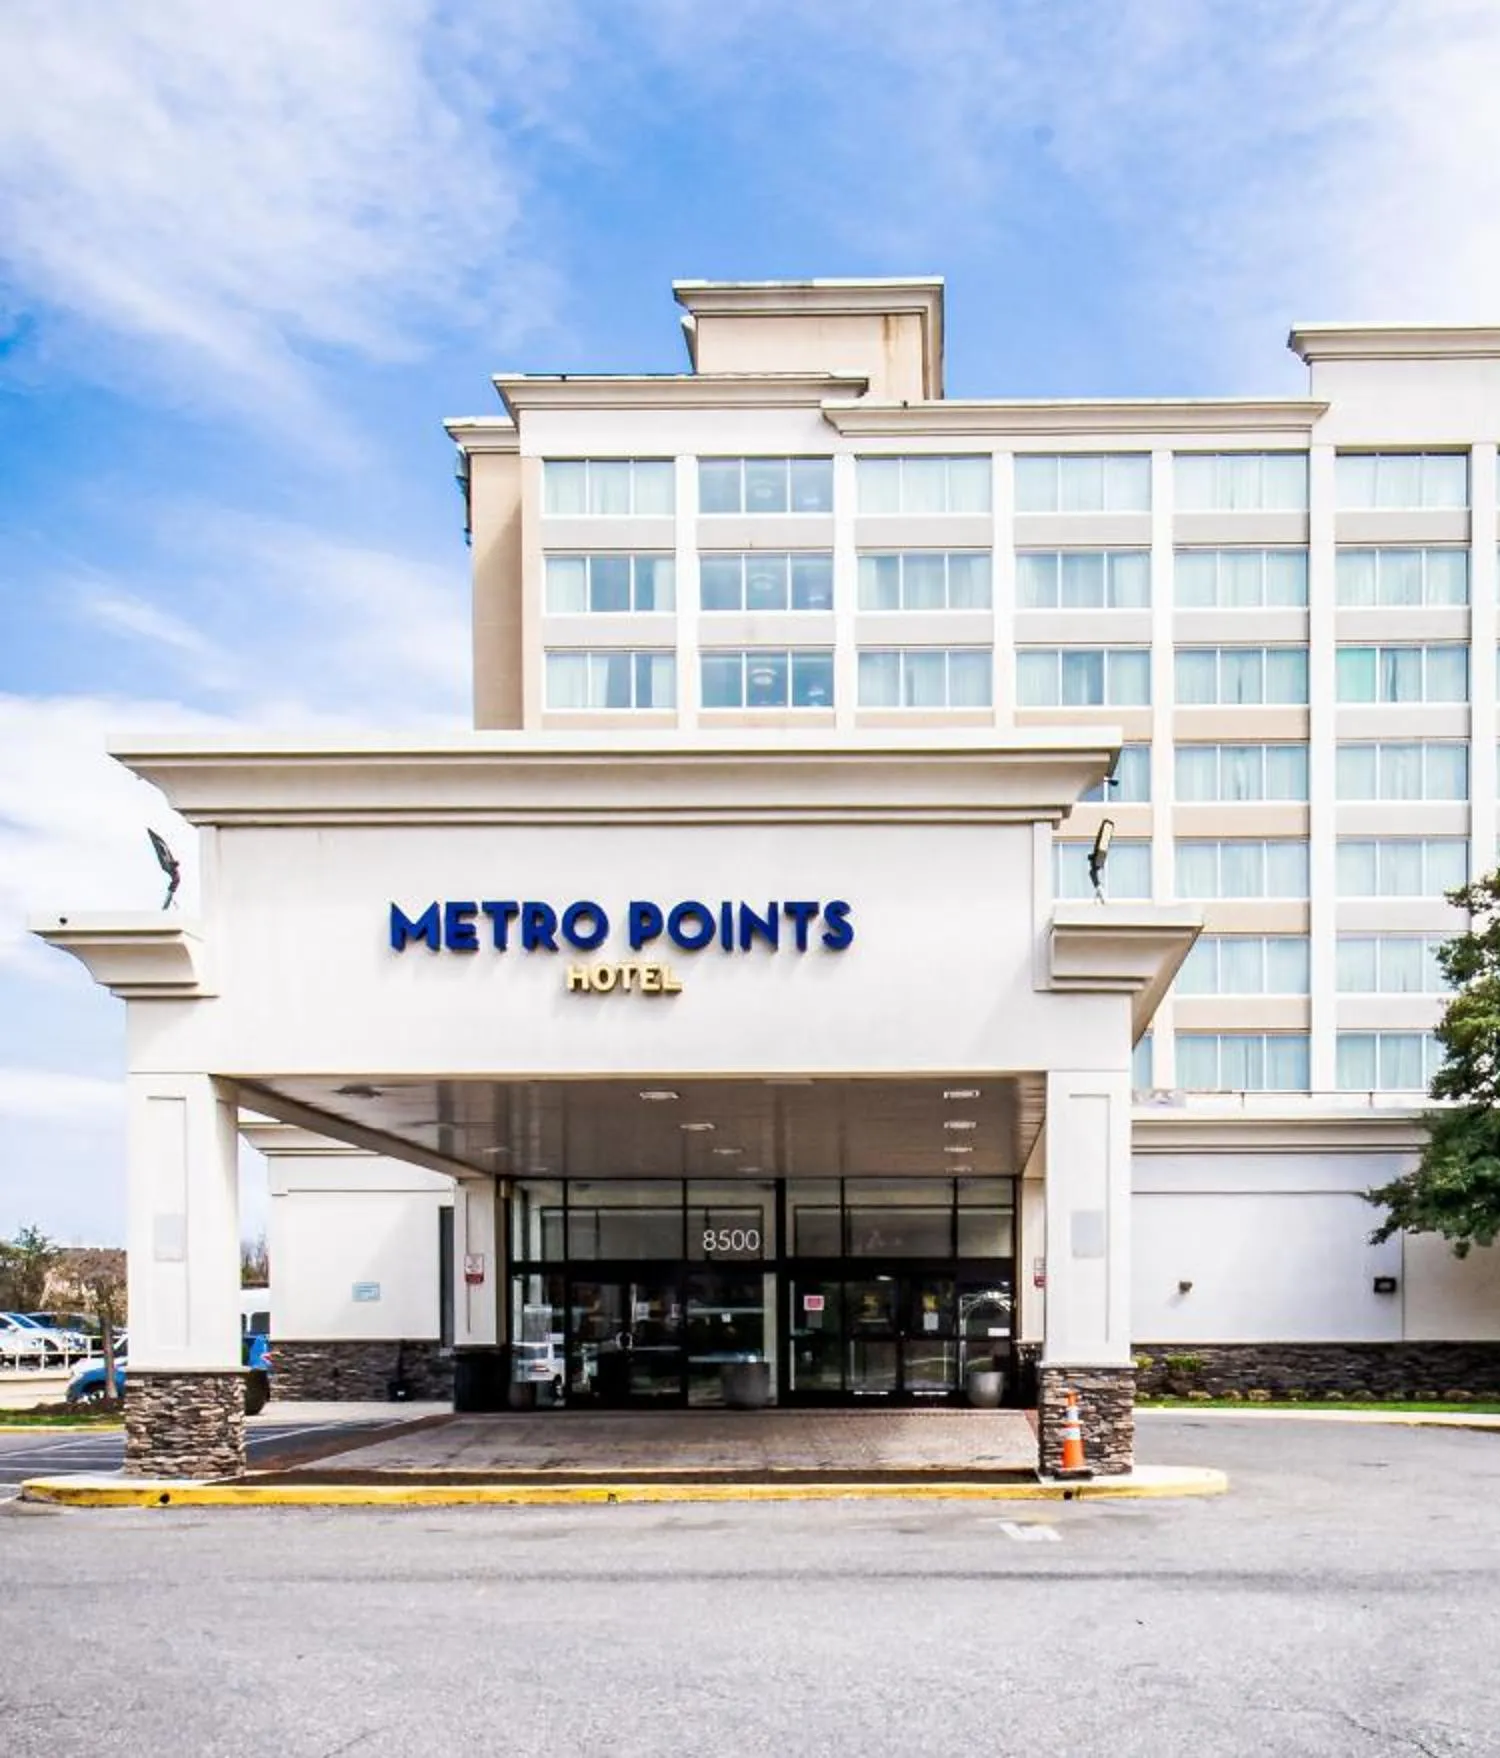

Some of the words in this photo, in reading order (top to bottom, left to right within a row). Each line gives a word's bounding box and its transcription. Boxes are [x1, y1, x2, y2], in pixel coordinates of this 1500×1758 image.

[389, 900, 610, 952] METRO
[628, 900, 854, 952] POINTS
[566, 962, 682, 994] HOTEL
[703, 1229, 760, 1251] 8500
